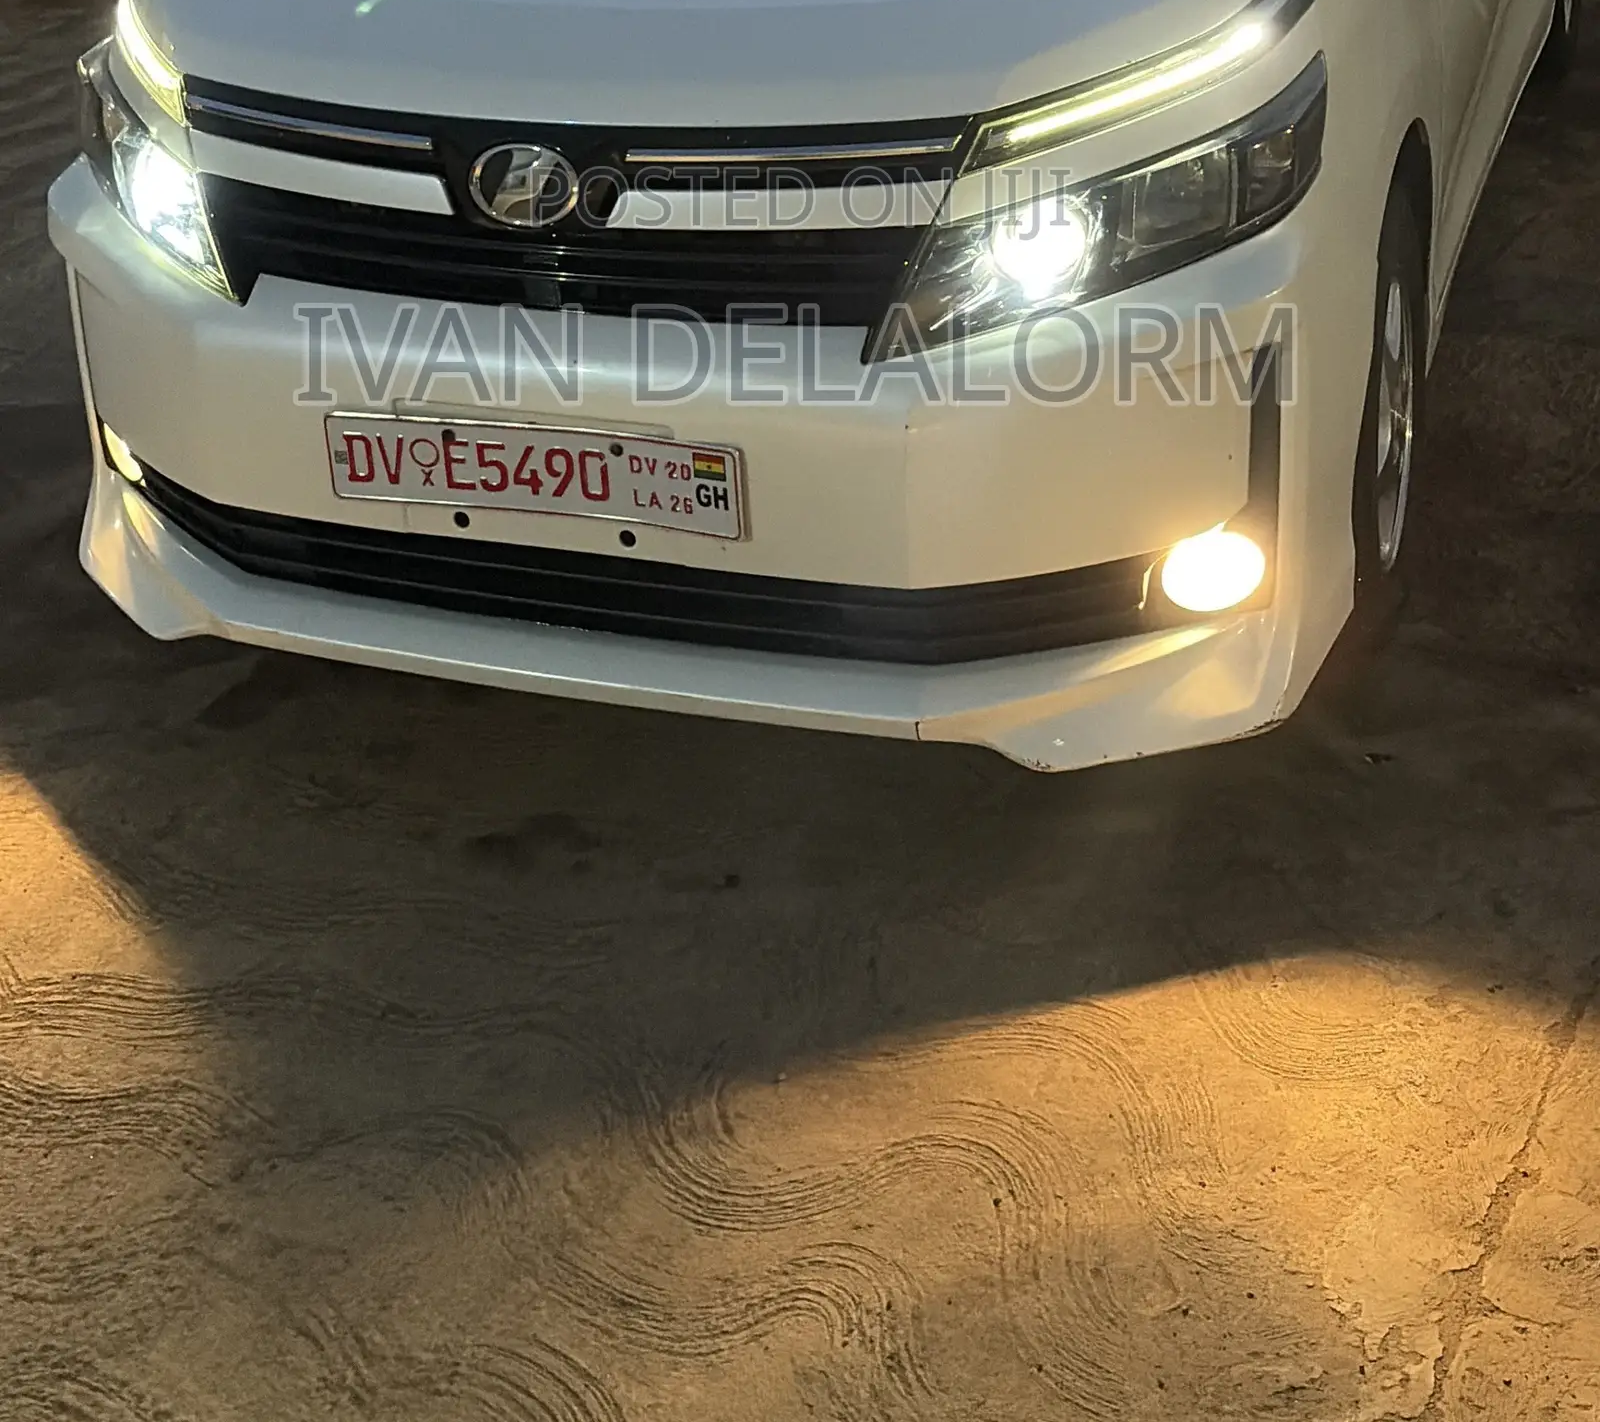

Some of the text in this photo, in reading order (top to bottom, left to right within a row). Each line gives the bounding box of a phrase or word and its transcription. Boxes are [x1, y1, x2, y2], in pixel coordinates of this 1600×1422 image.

[343, 431, 610, 502] DV E5490
[628, 454, 692, 481] DV 20
[633, 488, 693, 515] LA 26
[695, 483, 729, 511] GH
